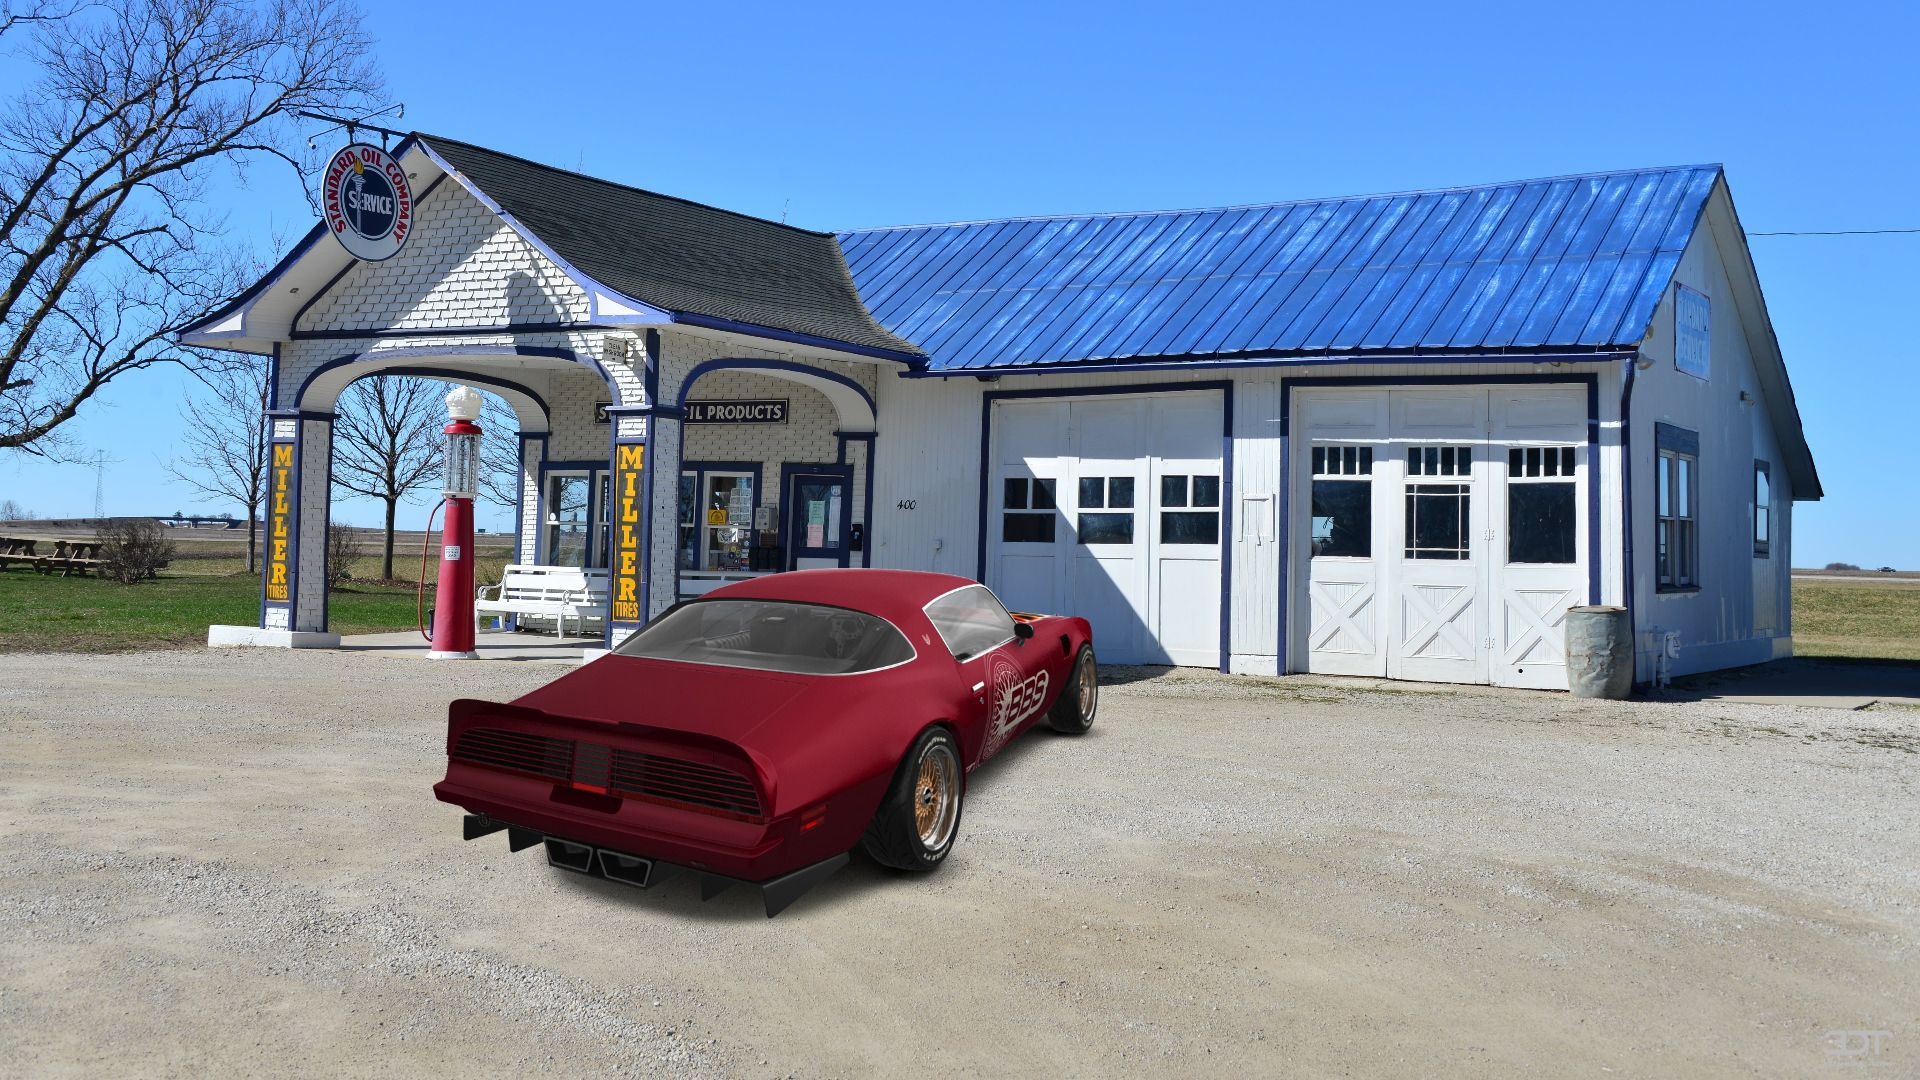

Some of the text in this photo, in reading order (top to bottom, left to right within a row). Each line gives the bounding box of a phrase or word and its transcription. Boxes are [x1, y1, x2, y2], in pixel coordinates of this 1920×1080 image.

[328, 148, 410, 245] STANDARD OIL COMPANY
[348, 190, 393, 215] SERVICE
[707, 405, 782, 420] PRODUCTS
[271, 445, 293, 584] MILLER
[896, 499, 917, 511] 400
[618, 445, 644, 601] MILLER
[268, 584, 288, 599] TIRES
[614, 601, 639, 618] TIRES
[1001, 670, 1048, 733] BBS
